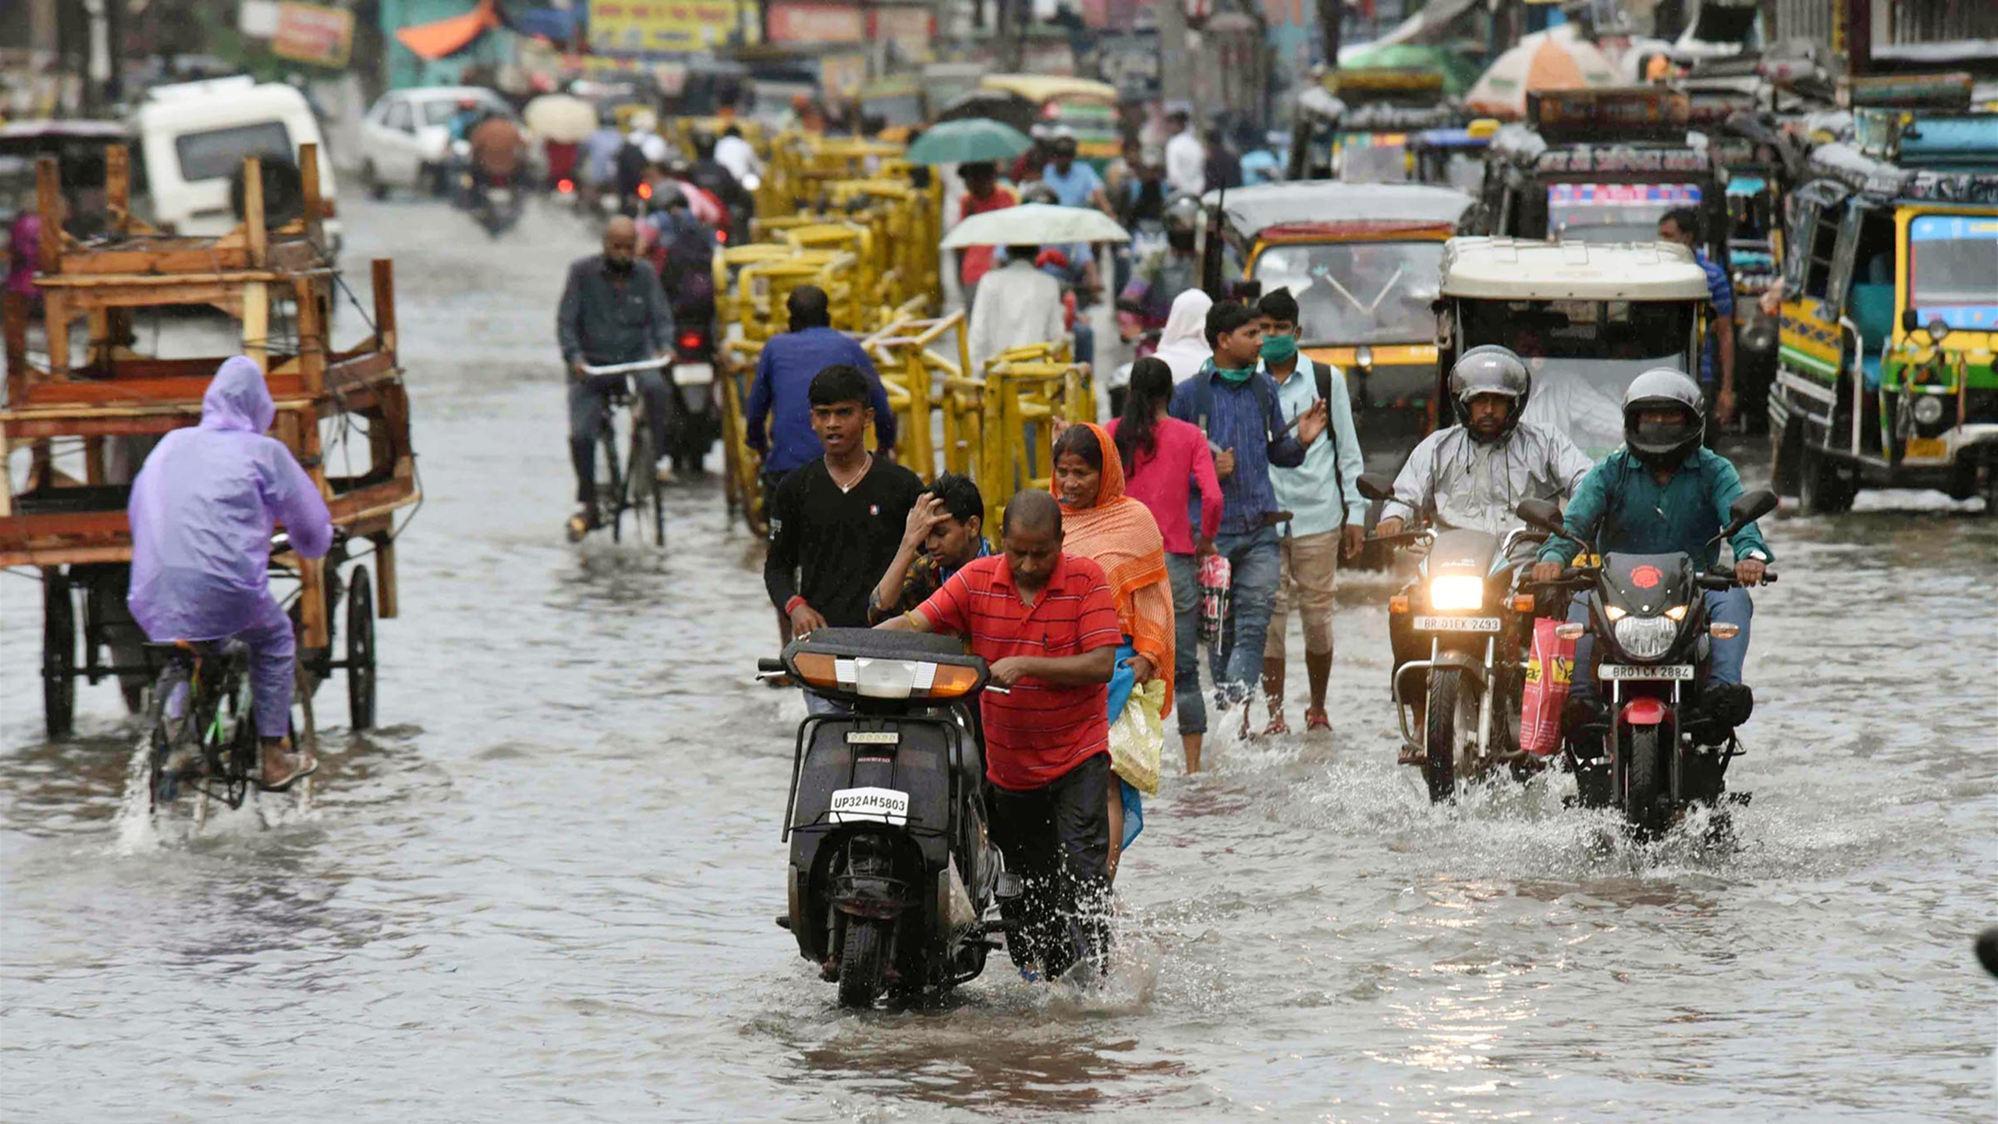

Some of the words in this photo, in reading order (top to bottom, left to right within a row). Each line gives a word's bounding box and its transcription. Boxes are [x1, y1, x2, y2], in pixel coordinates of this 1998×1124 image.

[1424, 618, 1437, 629] BR
[1472, 619, 1499, 630] 2493
[1660, 666, 1689, 678] 2884
